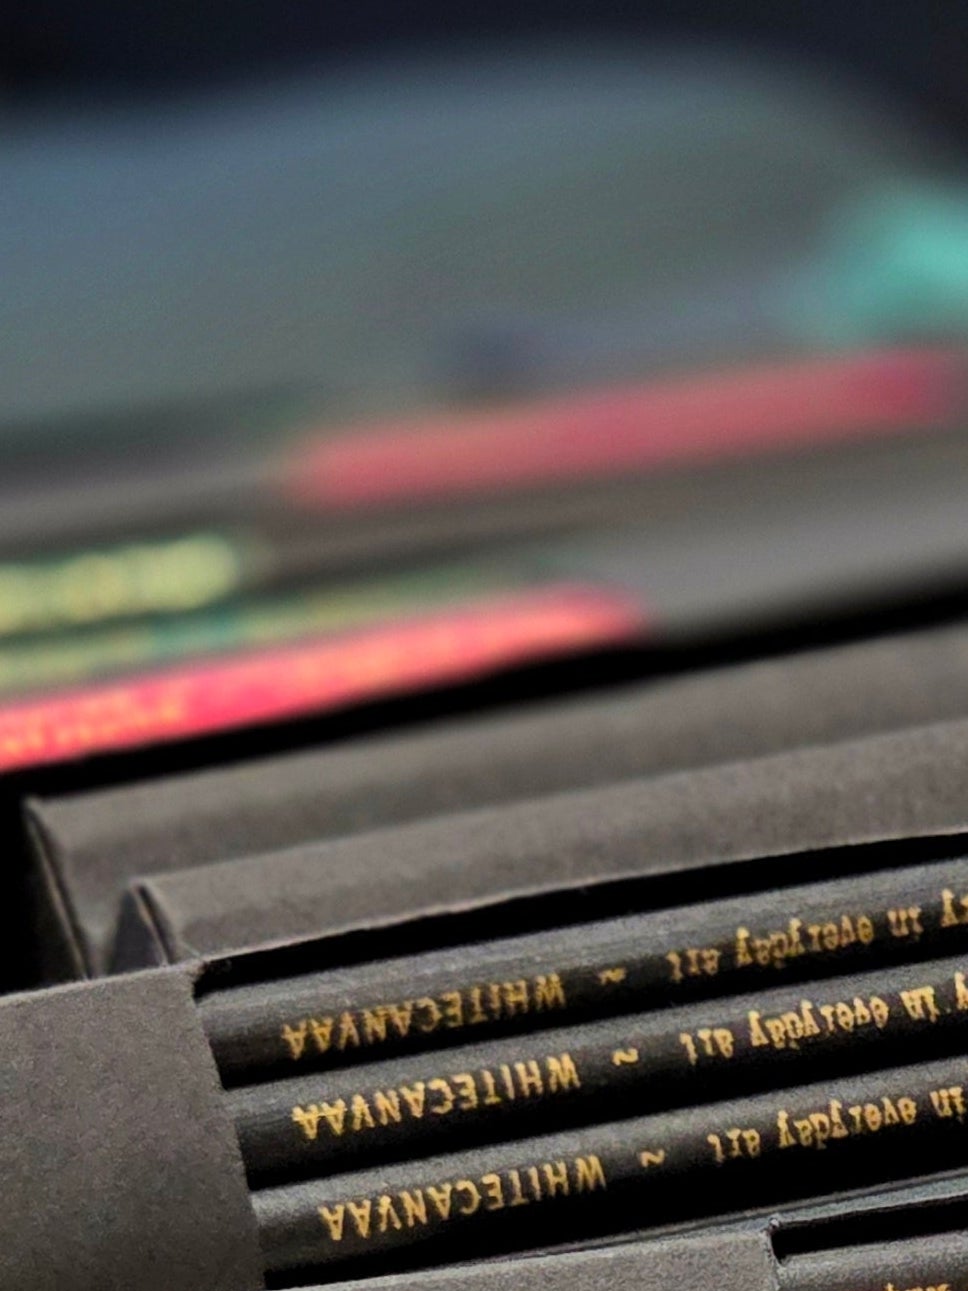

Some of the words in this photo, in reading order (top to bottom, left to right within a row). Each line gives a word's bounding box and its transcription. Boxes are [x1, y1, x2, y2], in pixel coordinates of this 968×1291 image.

[281, 972, 566, 1060] WHITECANVAA
[292, 1052, 581, 1140] WHITECANVAA
[318, 1154, 607, 1241] WHITECANVAA
